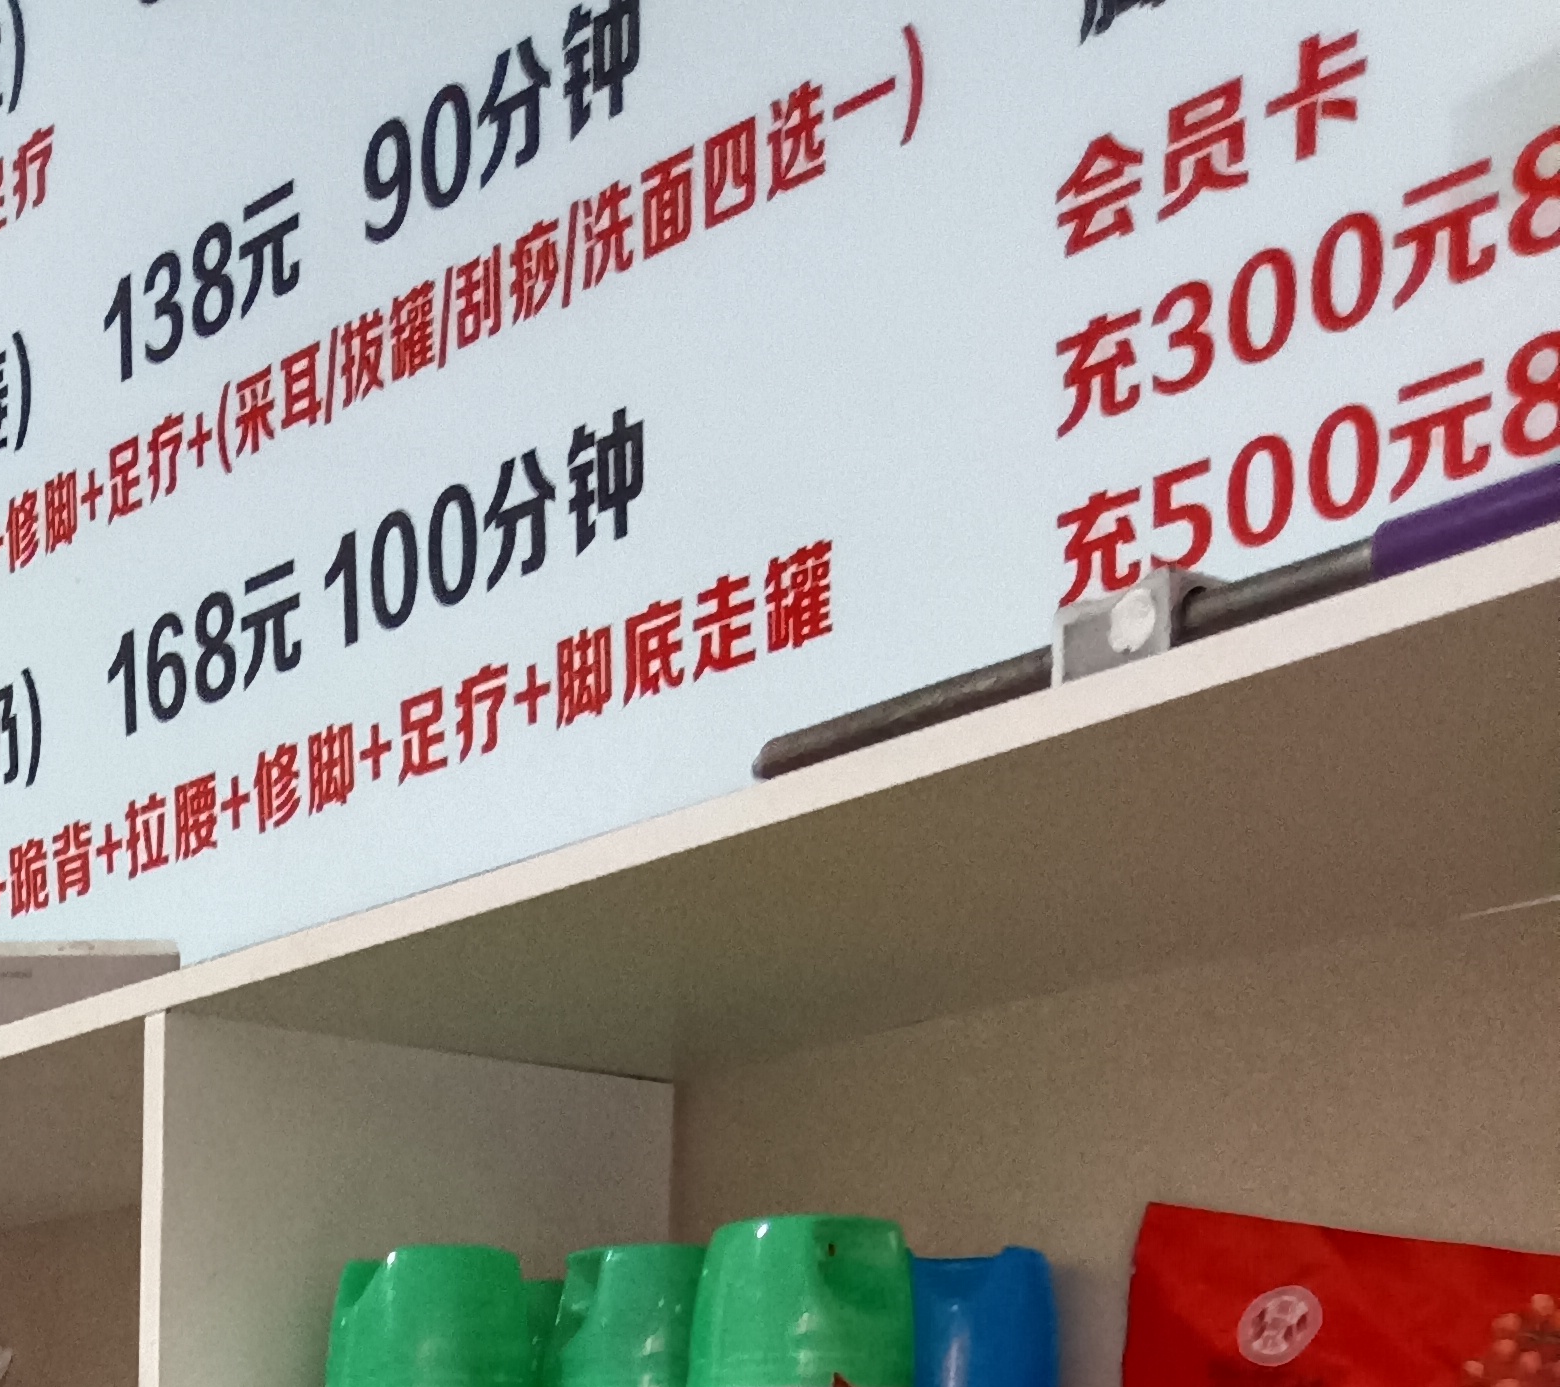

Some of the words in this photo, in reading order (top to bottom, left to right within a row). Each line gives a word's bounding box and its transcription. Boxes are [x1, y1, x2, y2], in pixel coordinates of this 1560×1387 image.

[104, 179, 302, 382] 138元
[363, 0, 642, 244] 90分钟
[1056, 30, 1368, 257] 会员卡
[108, 559, 302, 736] 168元
[325, 406, 645, 648] 100分钟
